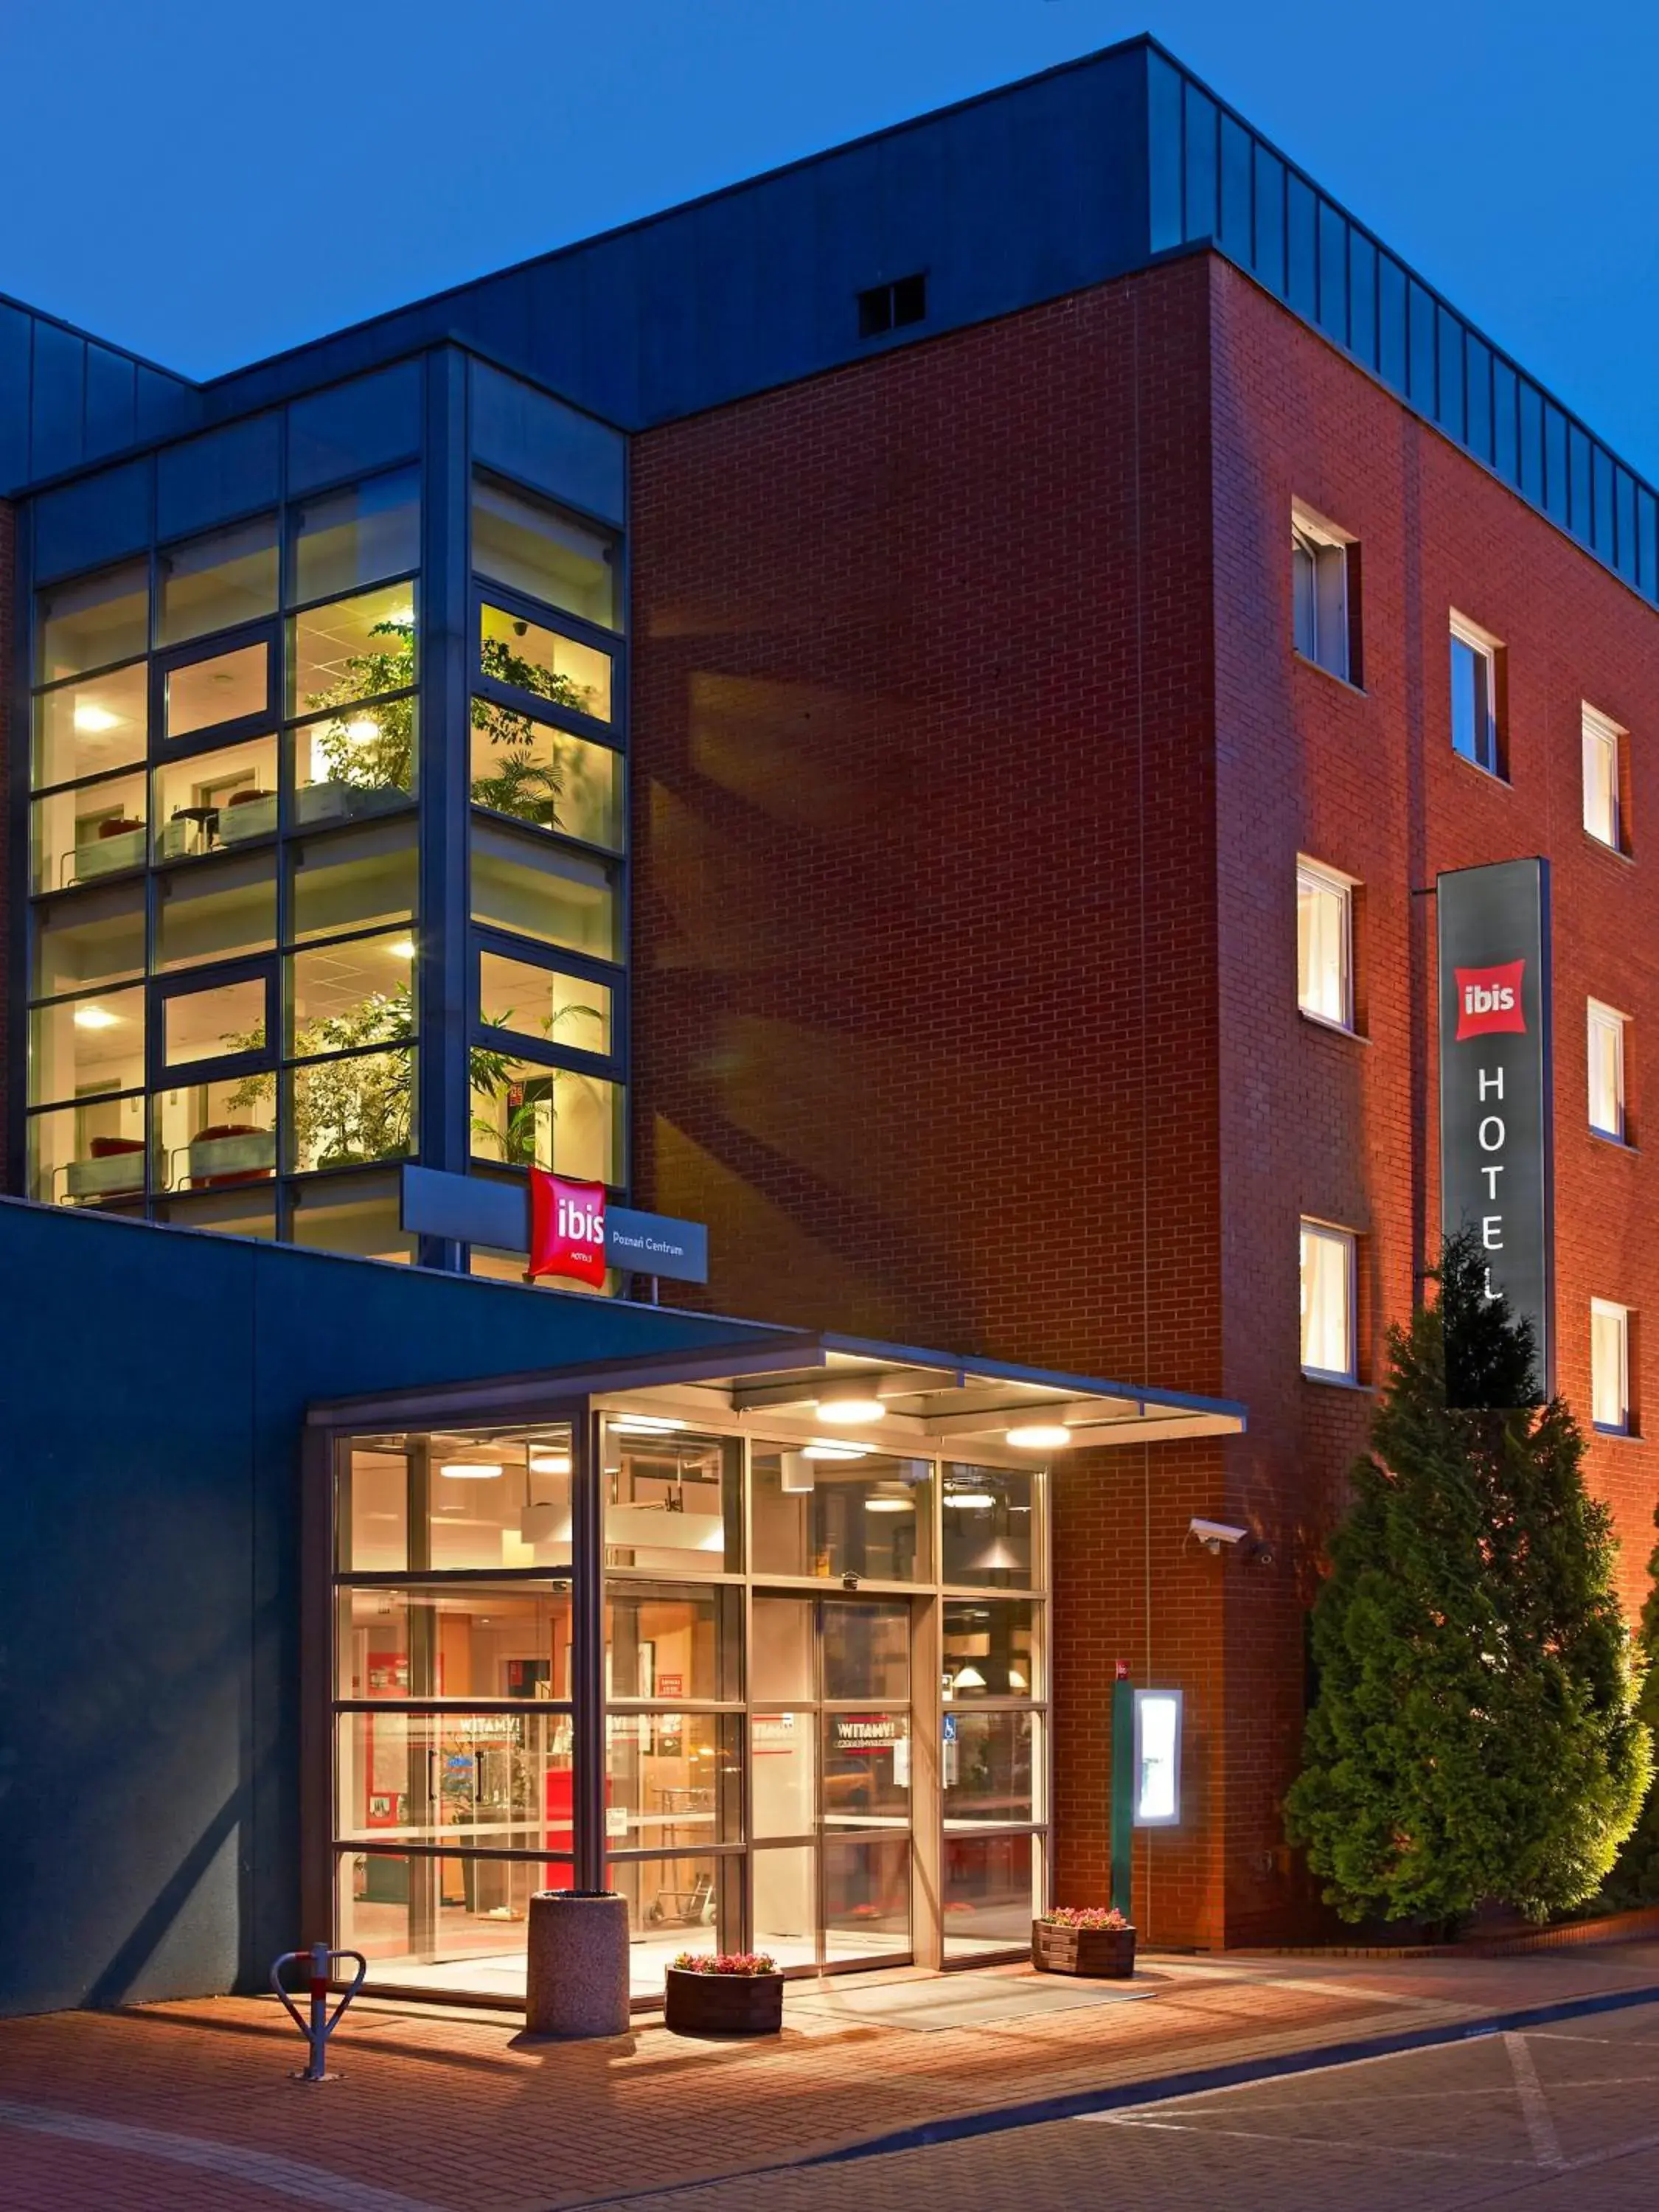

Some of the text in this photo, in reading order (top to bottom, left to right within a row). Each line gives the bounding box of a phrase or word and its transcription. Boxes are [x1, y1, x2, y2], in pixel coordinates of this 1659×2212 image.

[1464, 984, 1514, 1015] ibis
[1478, 1066, 1506, 1300] HOTEL
[558, 1198, 604, 1244] ibis
[613, 1231, 684, 1256] Poznań Centrum
